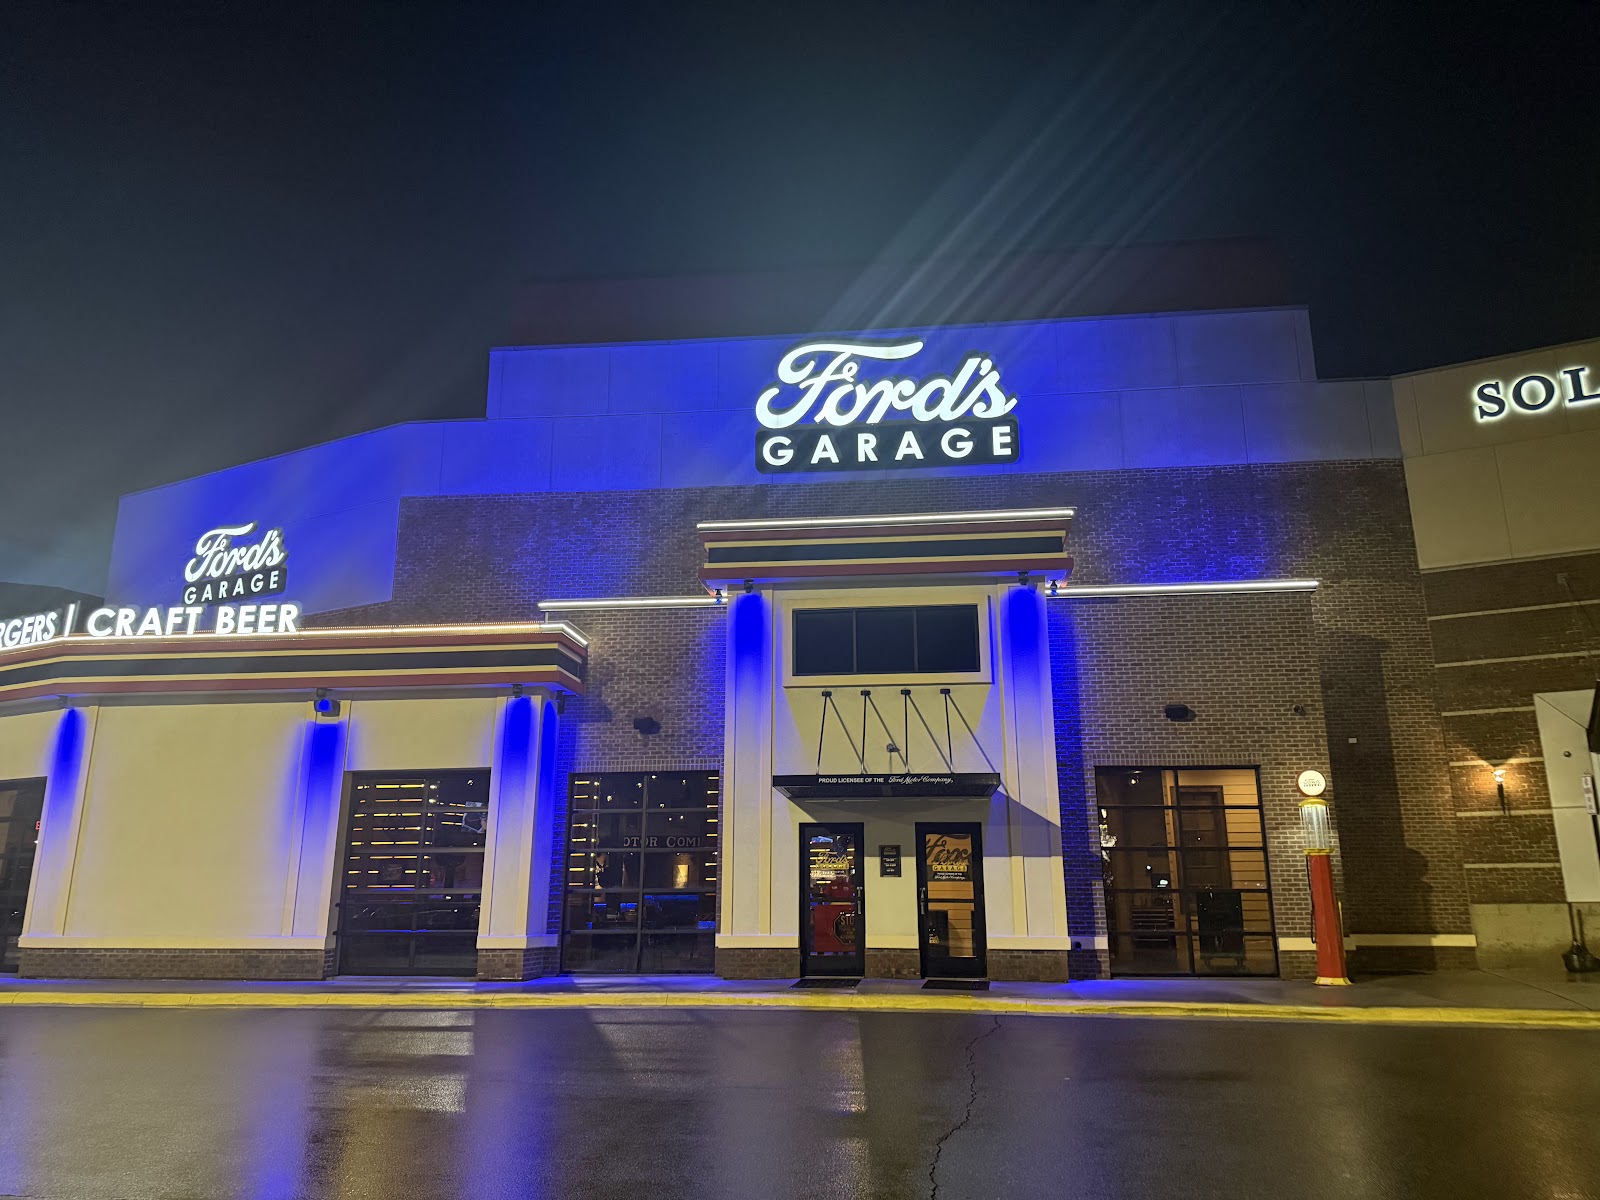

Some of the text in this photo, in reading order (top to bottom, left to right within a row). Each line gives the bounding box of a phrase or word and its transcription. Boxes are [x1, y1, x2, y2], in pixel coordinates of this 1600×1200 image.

[756, 341, 1018, 429] Ford's
[1477, 366, 1600, 420] SOL
[762, 425, 1012, 467] GARAGE
[184, 522, 286, 583] Ford's
[183, 570, 280, 605] GARAGE
[87, 606, 203, 637] CRAFT
[215, 604, 299, 636] BEER
[888, 775, 903, 784] Ford
